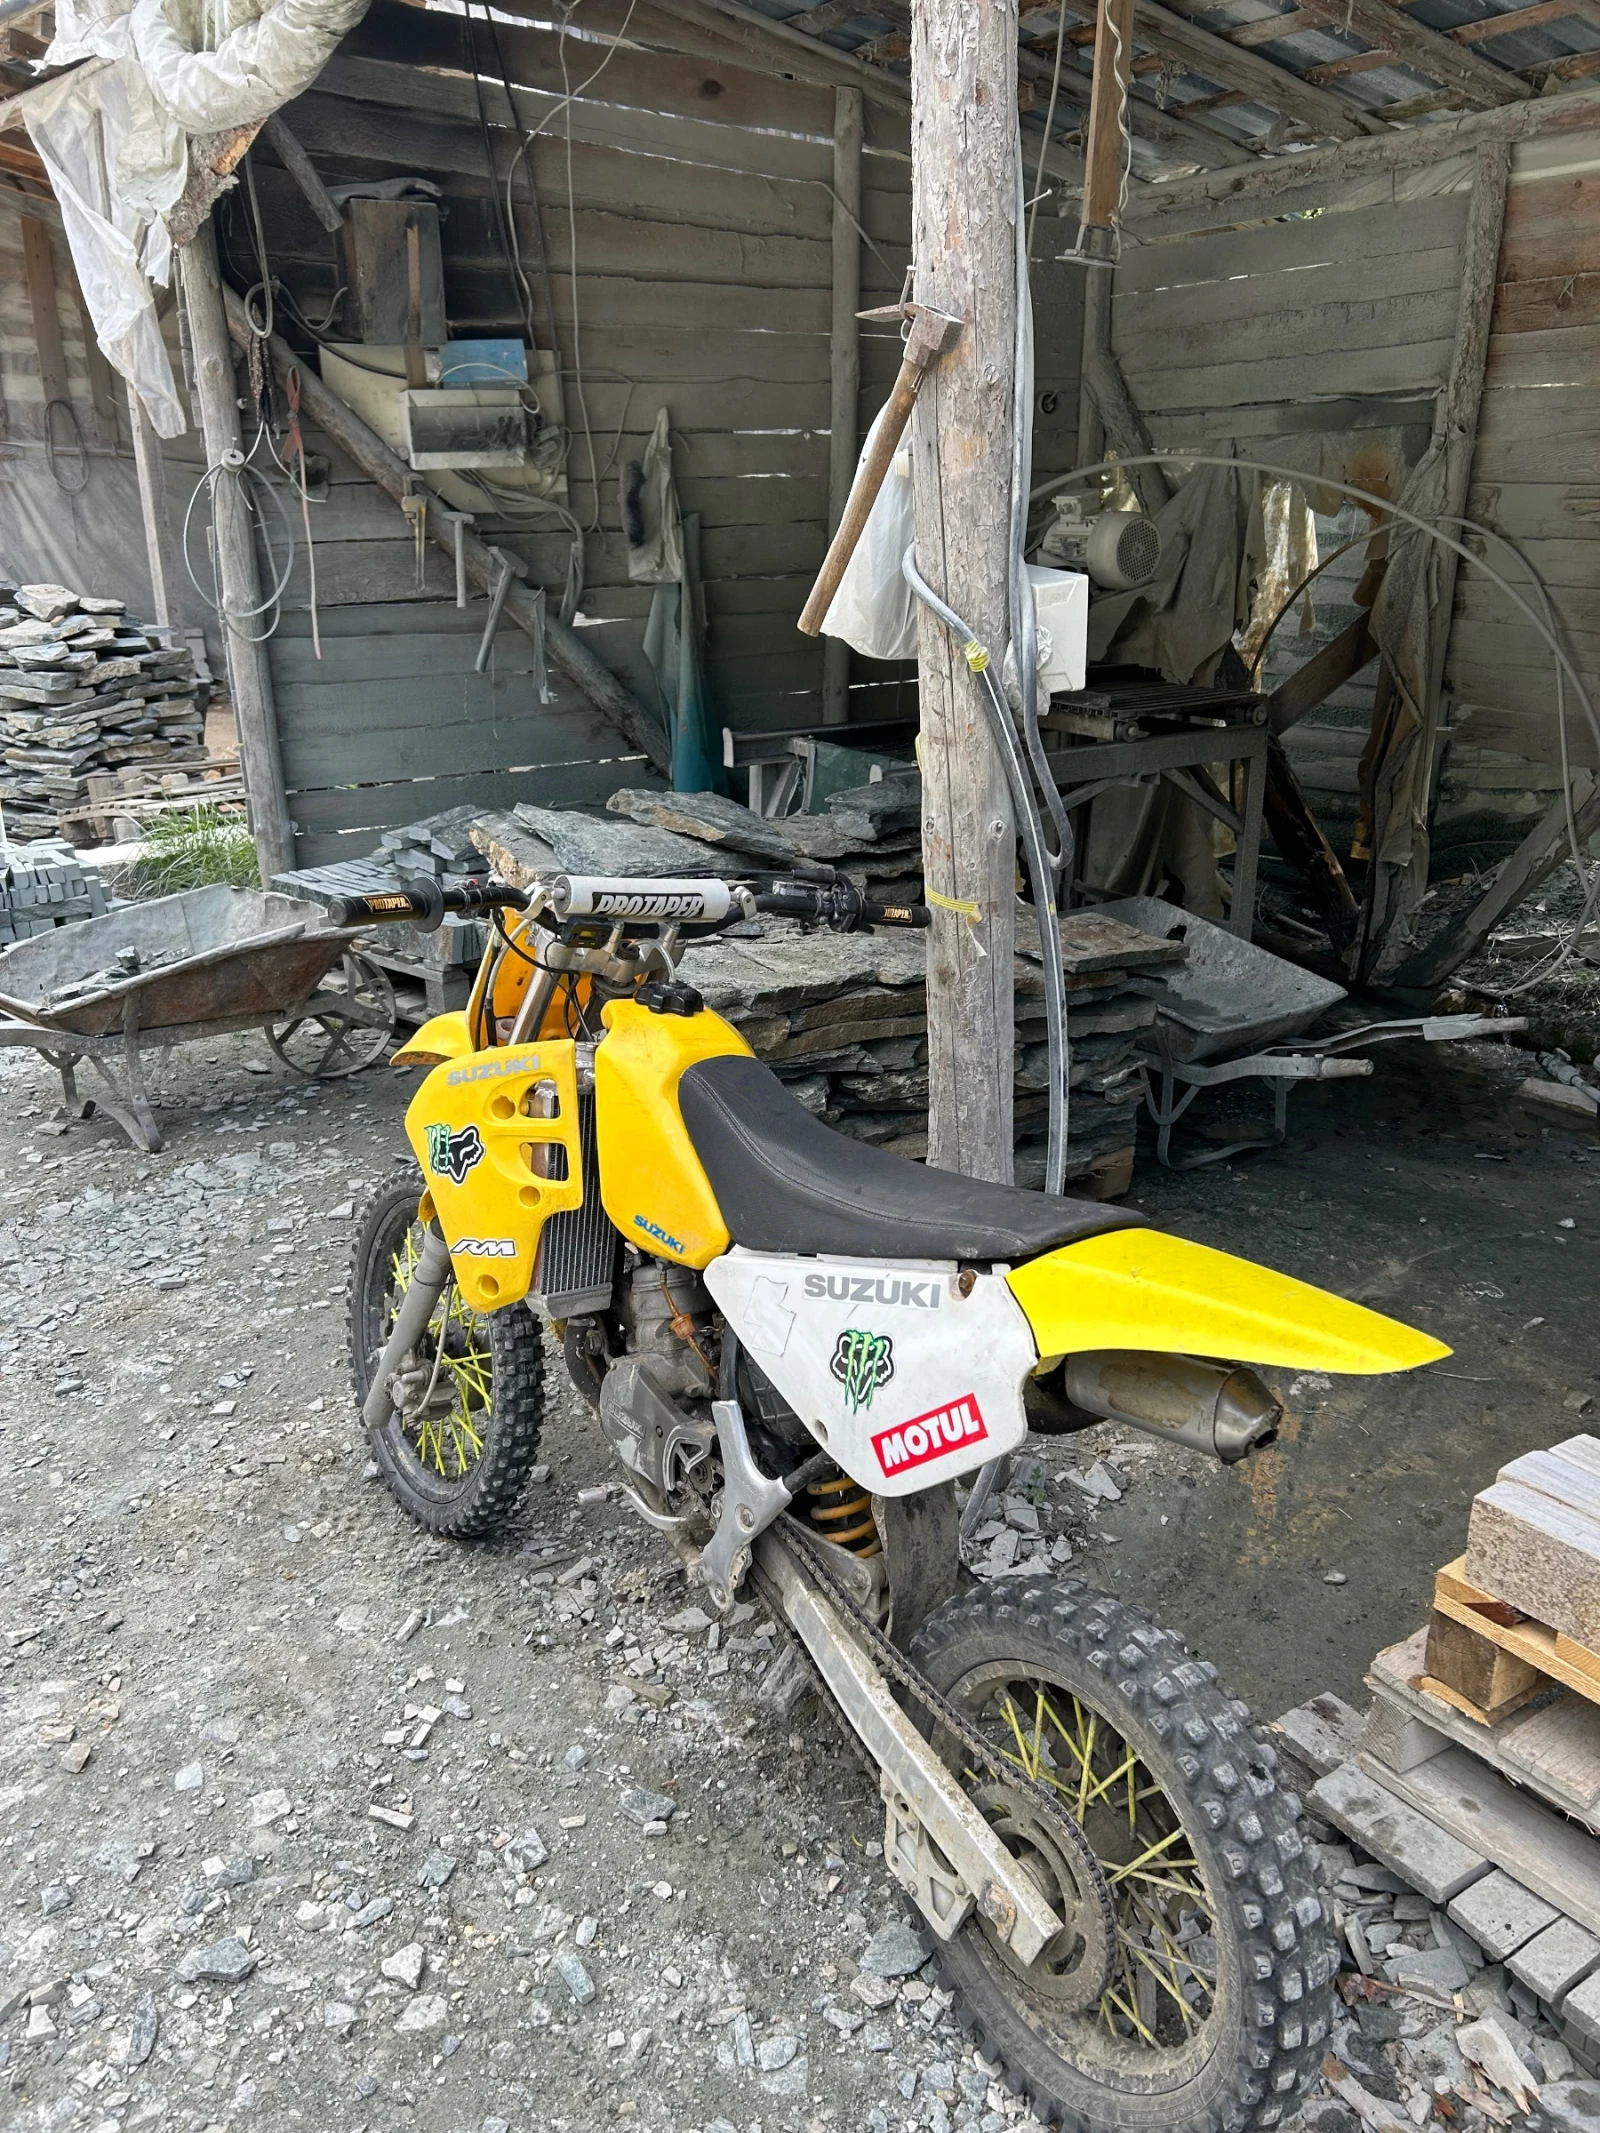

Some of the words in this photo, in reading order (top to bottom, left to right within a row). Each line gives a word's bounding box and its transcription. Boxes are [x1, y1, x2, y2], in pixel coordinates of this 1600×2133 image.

[368, 897, 406, 910] PROTAPER
[591, 894, 704, 918] PROTAPER
[447, 1055, 540, 1086] SUZUKI
[450, 1239, 516, 1256] RM
[633, 1214, 685, 1254] SUZUKI
[803, 1274, 941, 1309] SUZUKI
[880, 1401, 980, 1469] MOTUL
